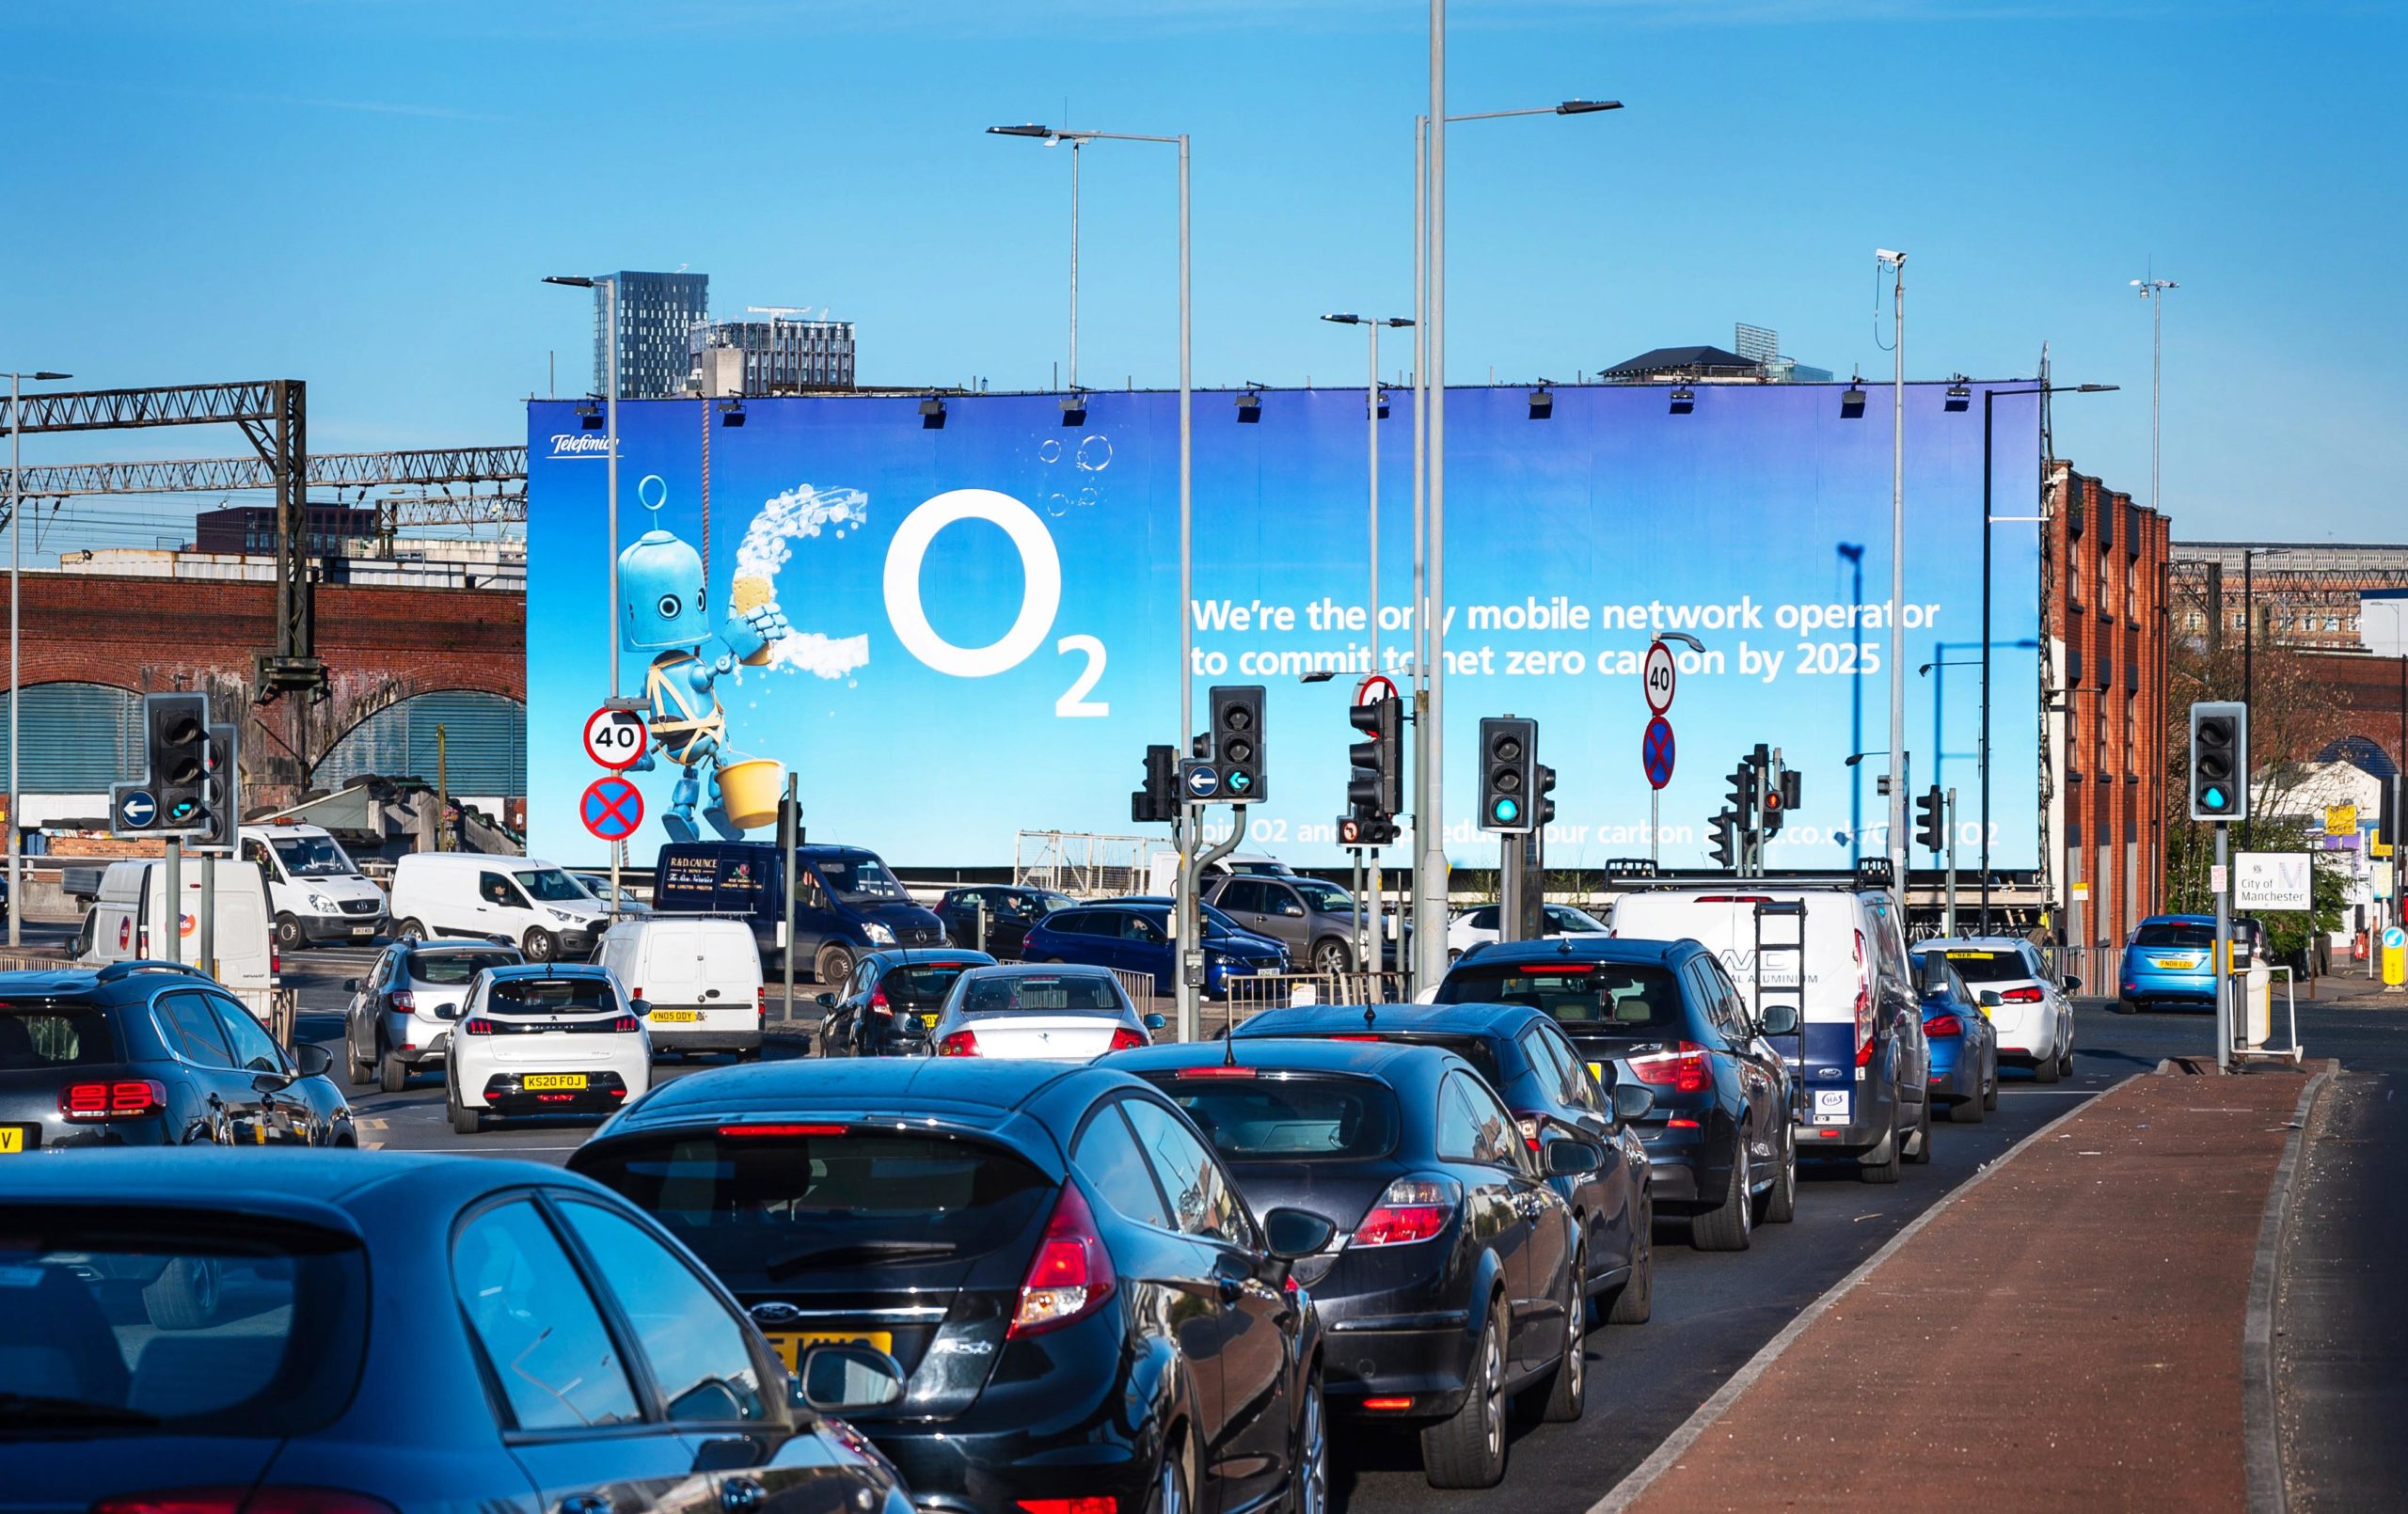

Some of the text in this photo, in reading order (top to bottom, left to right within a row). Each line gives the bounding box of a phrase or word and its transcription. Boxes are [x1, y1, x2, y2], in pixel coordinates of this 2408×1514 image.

[1192, 600, 1295, 631] We're
[1307, 597, 1366, 630] the
[1468, 596, 1590, 630] mobile
[1604, 595, 1763, 630] network
[1776, 598, 1941, 638] operator
[1192, 644, 1227, 675] to
[1240, 642, 1371, 675] commit
[1439, 646, 1494, 675] net
[1505, 650, 1585, 675] zero
[1740, 641, 1784, 684] by
[1798, 642, 1880, 675] 2025
[1650, 666, 1670, 691] 40
[595, 726, 634, 748] 40
[1251, 819, 1289, 844] O2
[1540, 824, 1590, 844] our
[1598, 818, 1693, 844] carbon
[2242, 878, 2273, 891] City of
[2242, 891, 2305, 902] Manchester
[1748, 974, 1819, 984] AUMINIM
[528, 1076, 581, 1087] KS20 FOJ
